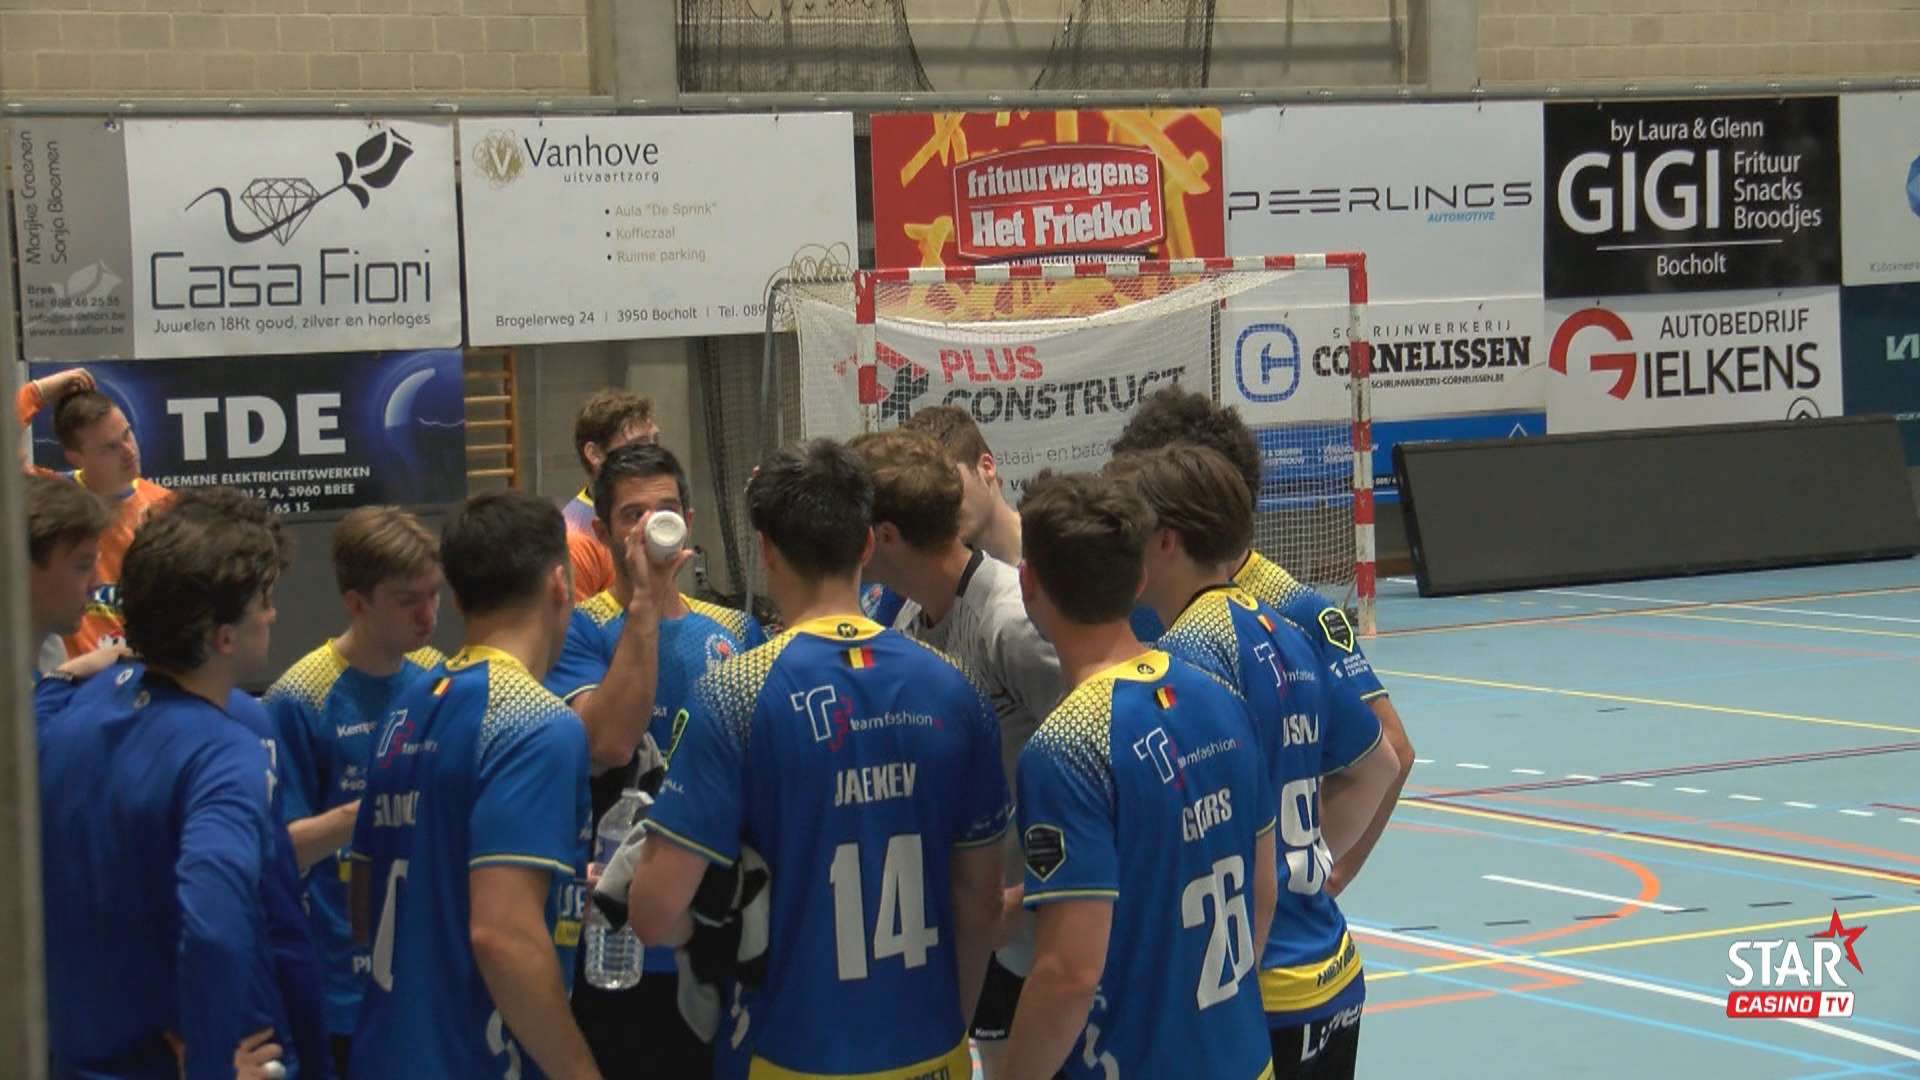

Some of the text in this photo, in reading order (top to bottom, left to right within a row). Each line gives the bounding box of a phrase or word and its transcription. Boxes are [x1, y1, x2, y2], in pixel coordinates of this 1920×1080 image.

[1610, 116, 1764, 146] by Laura & Glenn
[524, 135, 659, 168] Vanhove
[1733, 151, 1802, 174] Frituur
[564, 170, 660, 184] uitvaartzorg
[967, 161, 1149, 199] frituurwagens
[1733, 178, 1803, 203] Snacks
[1229, 182, 1532, 221] PEERLINGS
[1557, 149, 1720, 235] GIGI
[615, 205, 643, 217] Aula
[970, 200, 1153, 247] Het Frietkot
[1427, 211, 1496, 223] AUTOMOTIVE
[1734, 204, 1822, 233] Broodjes
[616, 248, 706, 264] Ruime parking
[1656, 253, 1727, 277] Bocholt
[151, 248, 431, 310] Casa Fiori
[153, 311, 431, 334] Juwelen 18Kt goud, zilver en horloges
[580, 311, 595, 323] 24
[617, 309, 649, 322] 3950
[652, 305, 698, 320] Bocholt
[718, 304, 738, 318] Tel.
[1659, 308, 1809, 339] AUTOBEDRIJF
[1332, 319, 1511, 340] SCRIJNWERKERIJ
[940, 344, 1044, 383] PLUS
[167, 393, 346, 461] TDE
[1047, 447, 1069, 462] en
[221, 466, 370, 484] ELEKTRICITEITSWERKEN
[289, 484, 320, 497] 3960
[325, 483, 355, 495] BREE
[831, 834, 939, 981] 14
[1182, 856, 1256, 1010] 26
